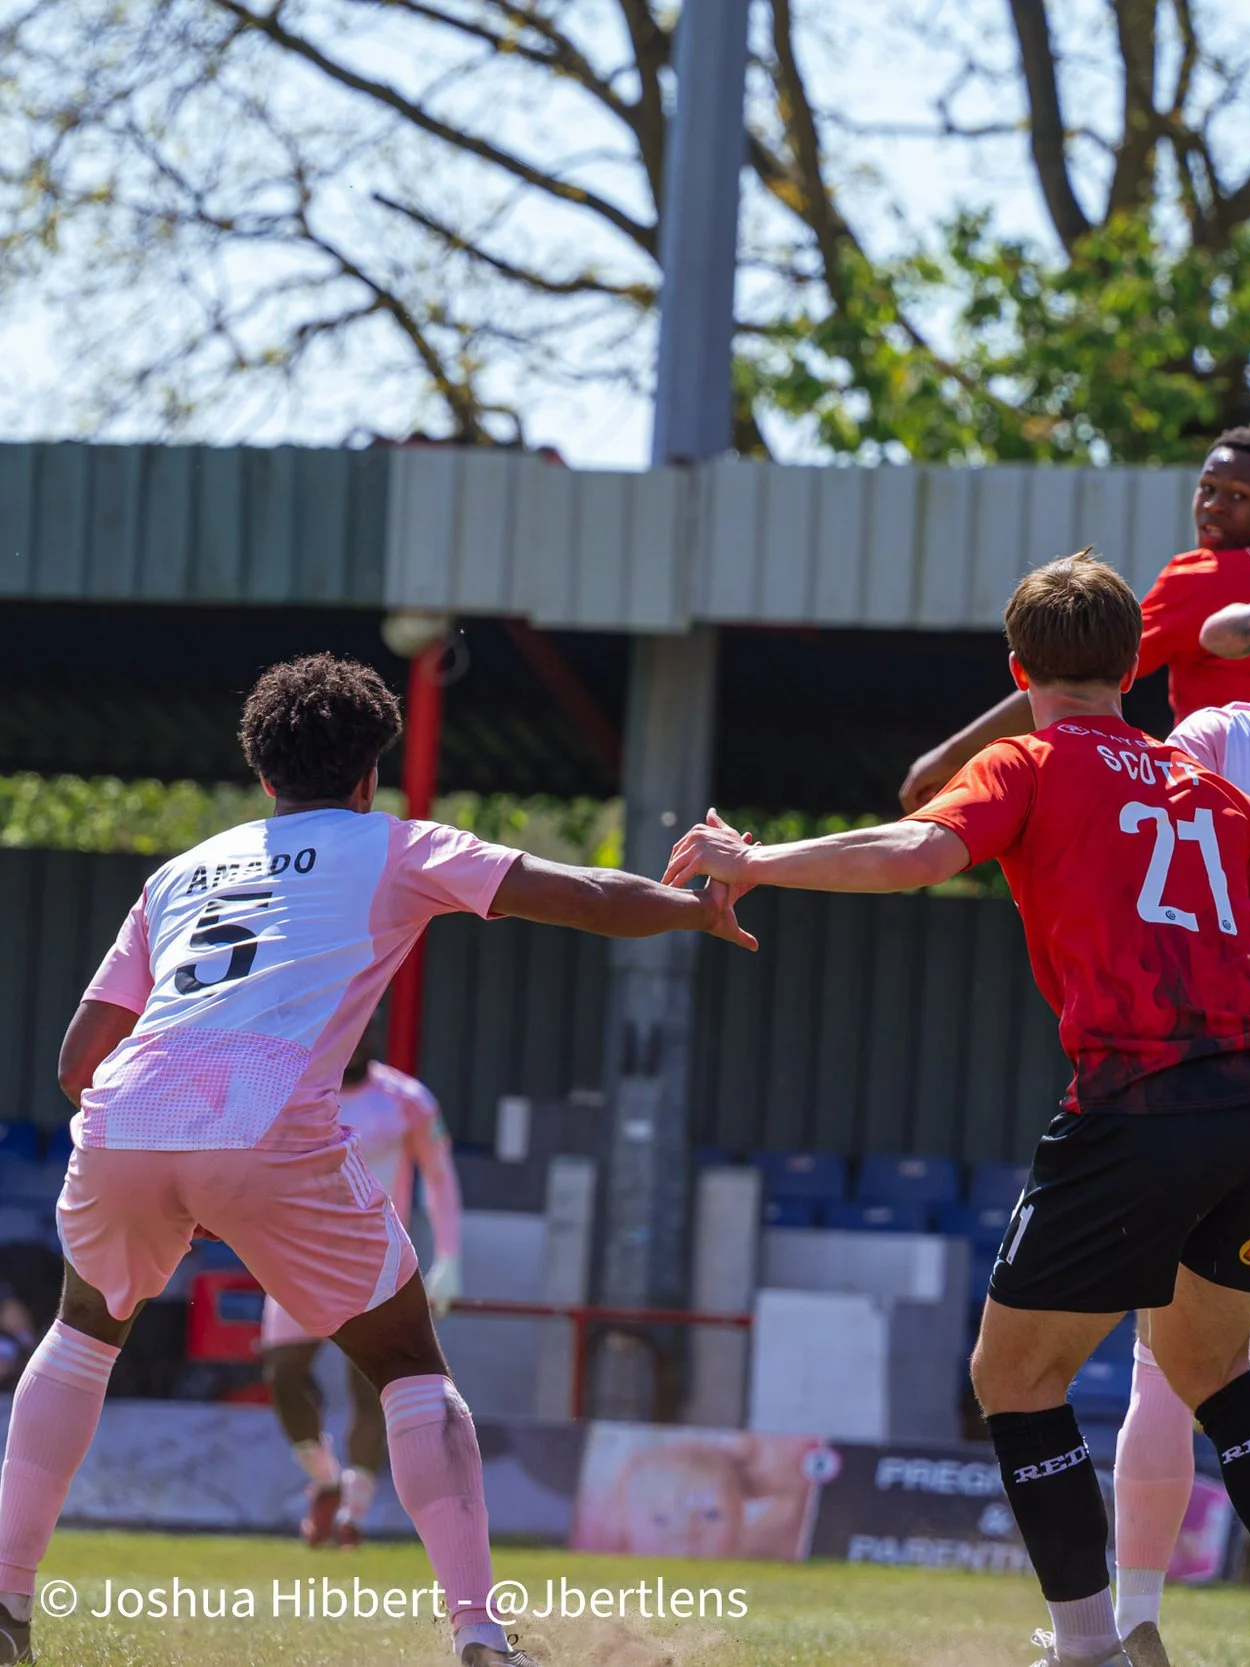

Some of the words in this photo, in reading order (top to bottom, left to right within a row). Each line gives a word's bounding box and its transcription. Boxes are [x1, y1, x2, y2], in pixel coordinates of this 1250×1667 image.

[1097, 745, 1199, 785] SCOTT
[1119, 801, 1238, 936] 21
[175, 892, 273, 998] 5
